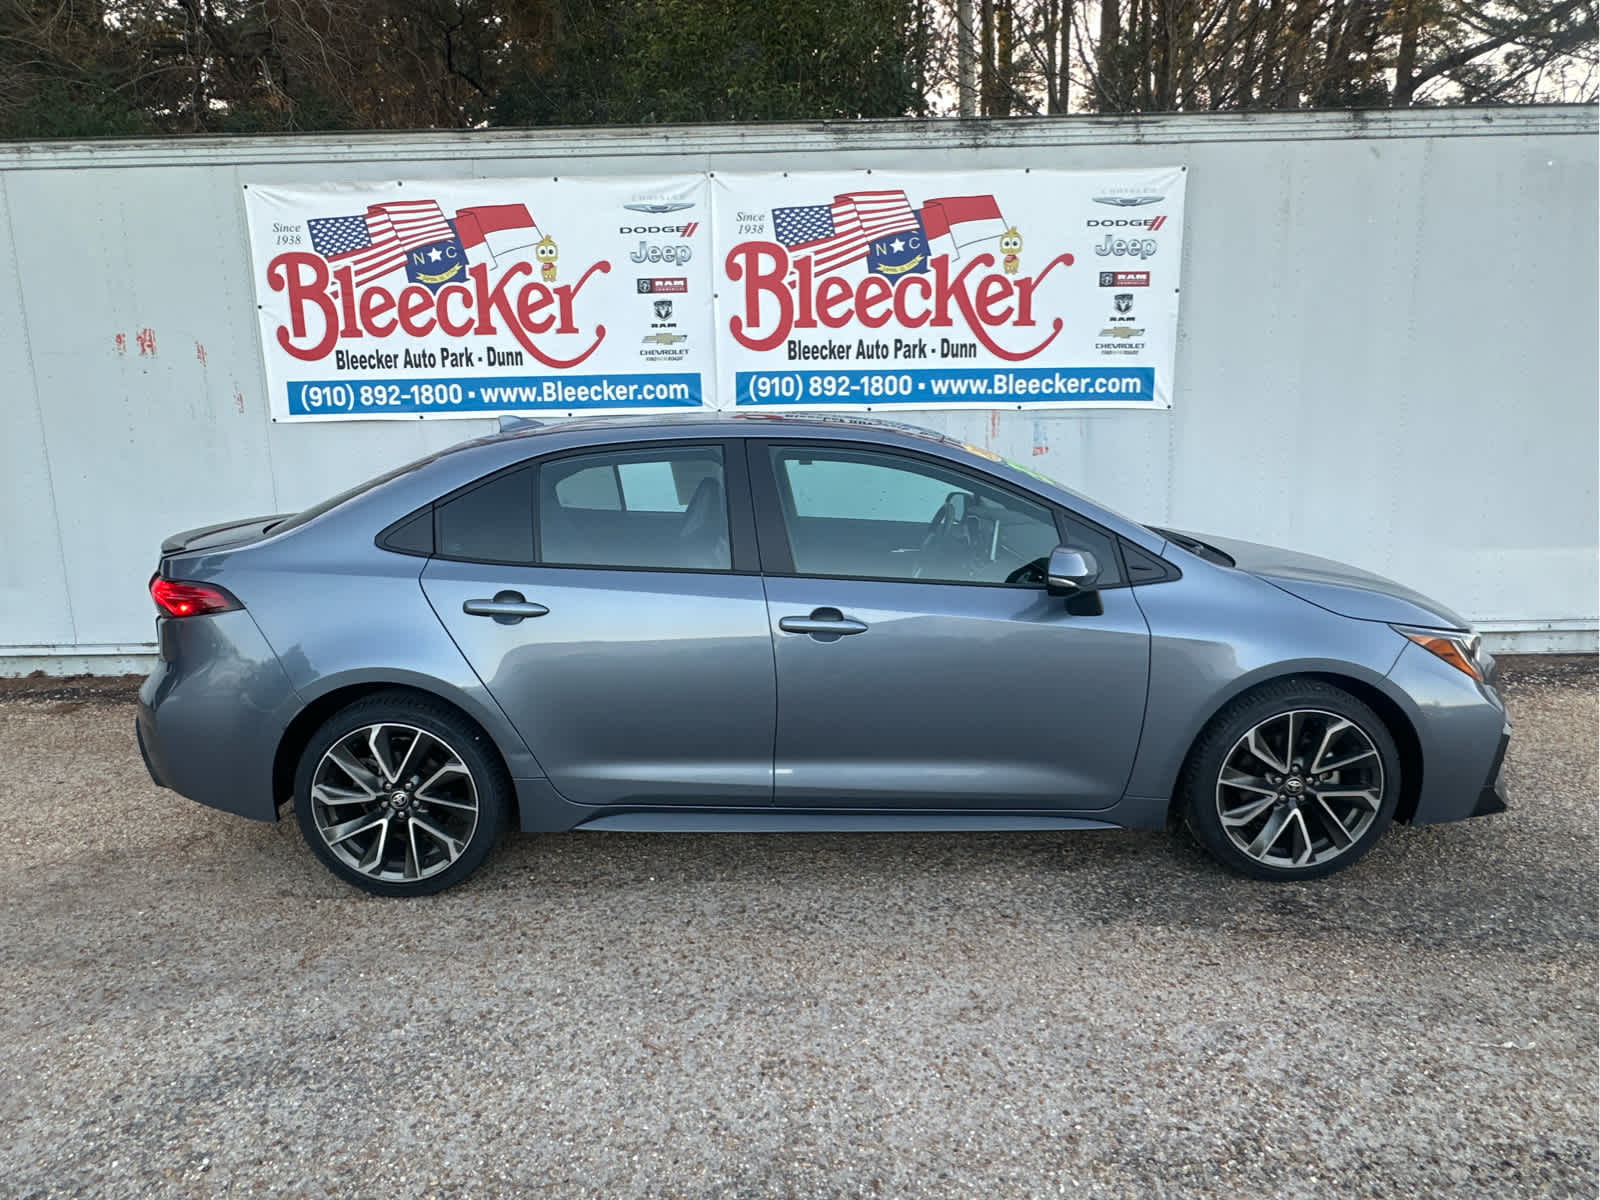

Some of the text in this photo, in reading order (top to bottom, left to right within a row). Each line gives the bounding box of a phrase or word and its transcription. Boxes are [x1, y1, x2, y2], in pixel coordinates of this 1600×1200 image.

[736, 211, 765, 222] Since
[1087, 219, 1154, 227] DODGE
[273, 223, 301, 233] Since
[619, 226, 688, 234] DODGE
[738, 224, 764, 234] 1938
[276, 235, 301, 245] 1938
[875, 237, 920, 256] N C
[1095, 235, 1157, 260] Jeep
[413, 246, 457, 266] N C
[630, 241, 692, 266] Jeep
[267, 252, 611, 369] Bleecker
[725, 241, 1074, 361] Bleecker
[336, 346, 524, 370] Bleecker Auto Park Dunn
[787, 338, 977, 360] Bleecker Auto Park Dunn
[301, 380, 689, 410] (910) 892-1800 www.Bleecker.com
[749, 373, 1141, 400] (910) 892-1800 www.Bleecker.com
